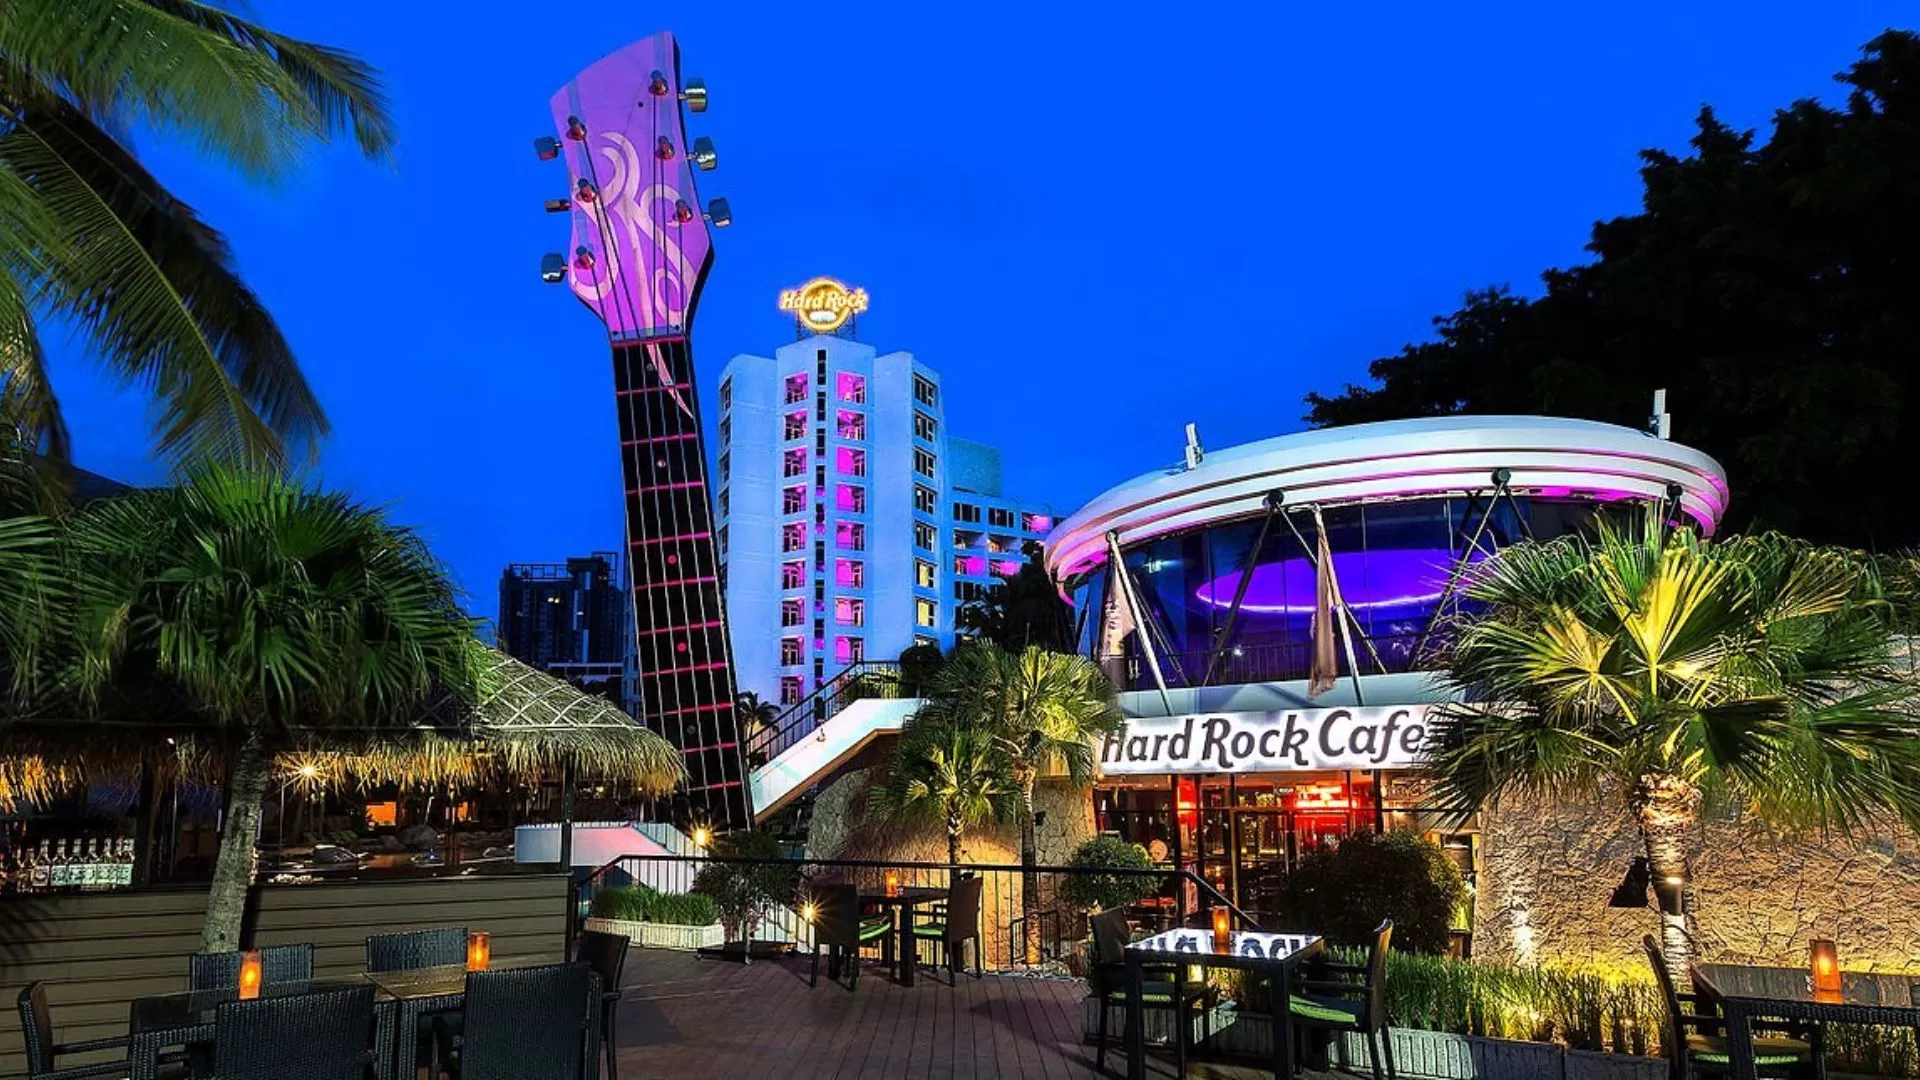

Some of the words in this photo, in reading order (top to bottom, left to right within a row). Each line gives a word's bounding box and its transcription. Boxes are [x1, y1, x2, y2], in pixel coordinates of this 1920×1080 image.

[780, 289, 825, 309] Hard
[825, 288, 868, 312] Rock
[1201, 715, 1309, 769] Rock
[1318, 709, 1425, 764] Cafe
